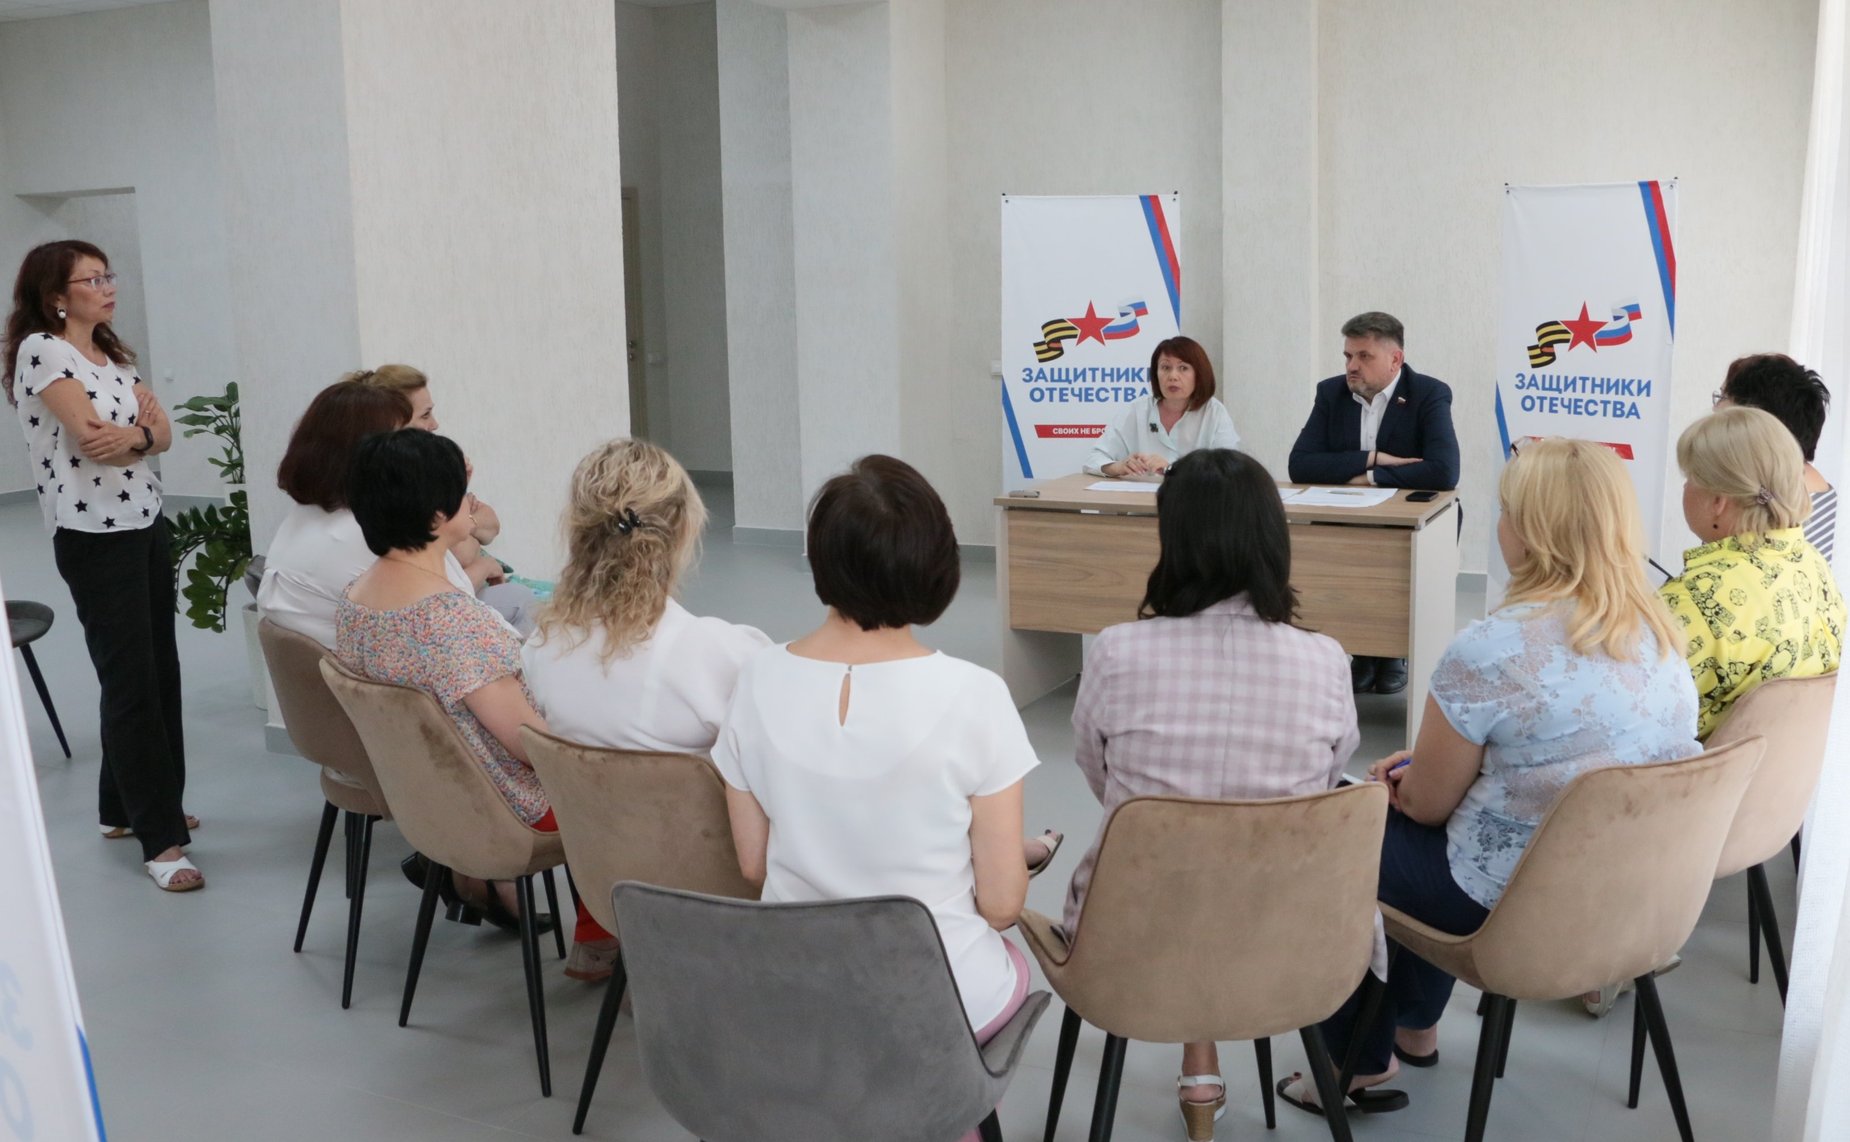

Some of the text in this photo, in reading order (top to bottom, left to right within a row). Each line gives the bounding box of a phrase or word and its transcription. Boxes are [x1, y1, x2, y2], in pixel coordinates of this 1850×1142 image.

[1515, 373, 1651, 397] ЗАЩИТНИКИ
[1521, 395, 1641, 419] ОТЕЧЕСТВА
[1052, 427, 1079, 435] СВОИХ
[1080, 427, 1090, 435] НЕ
